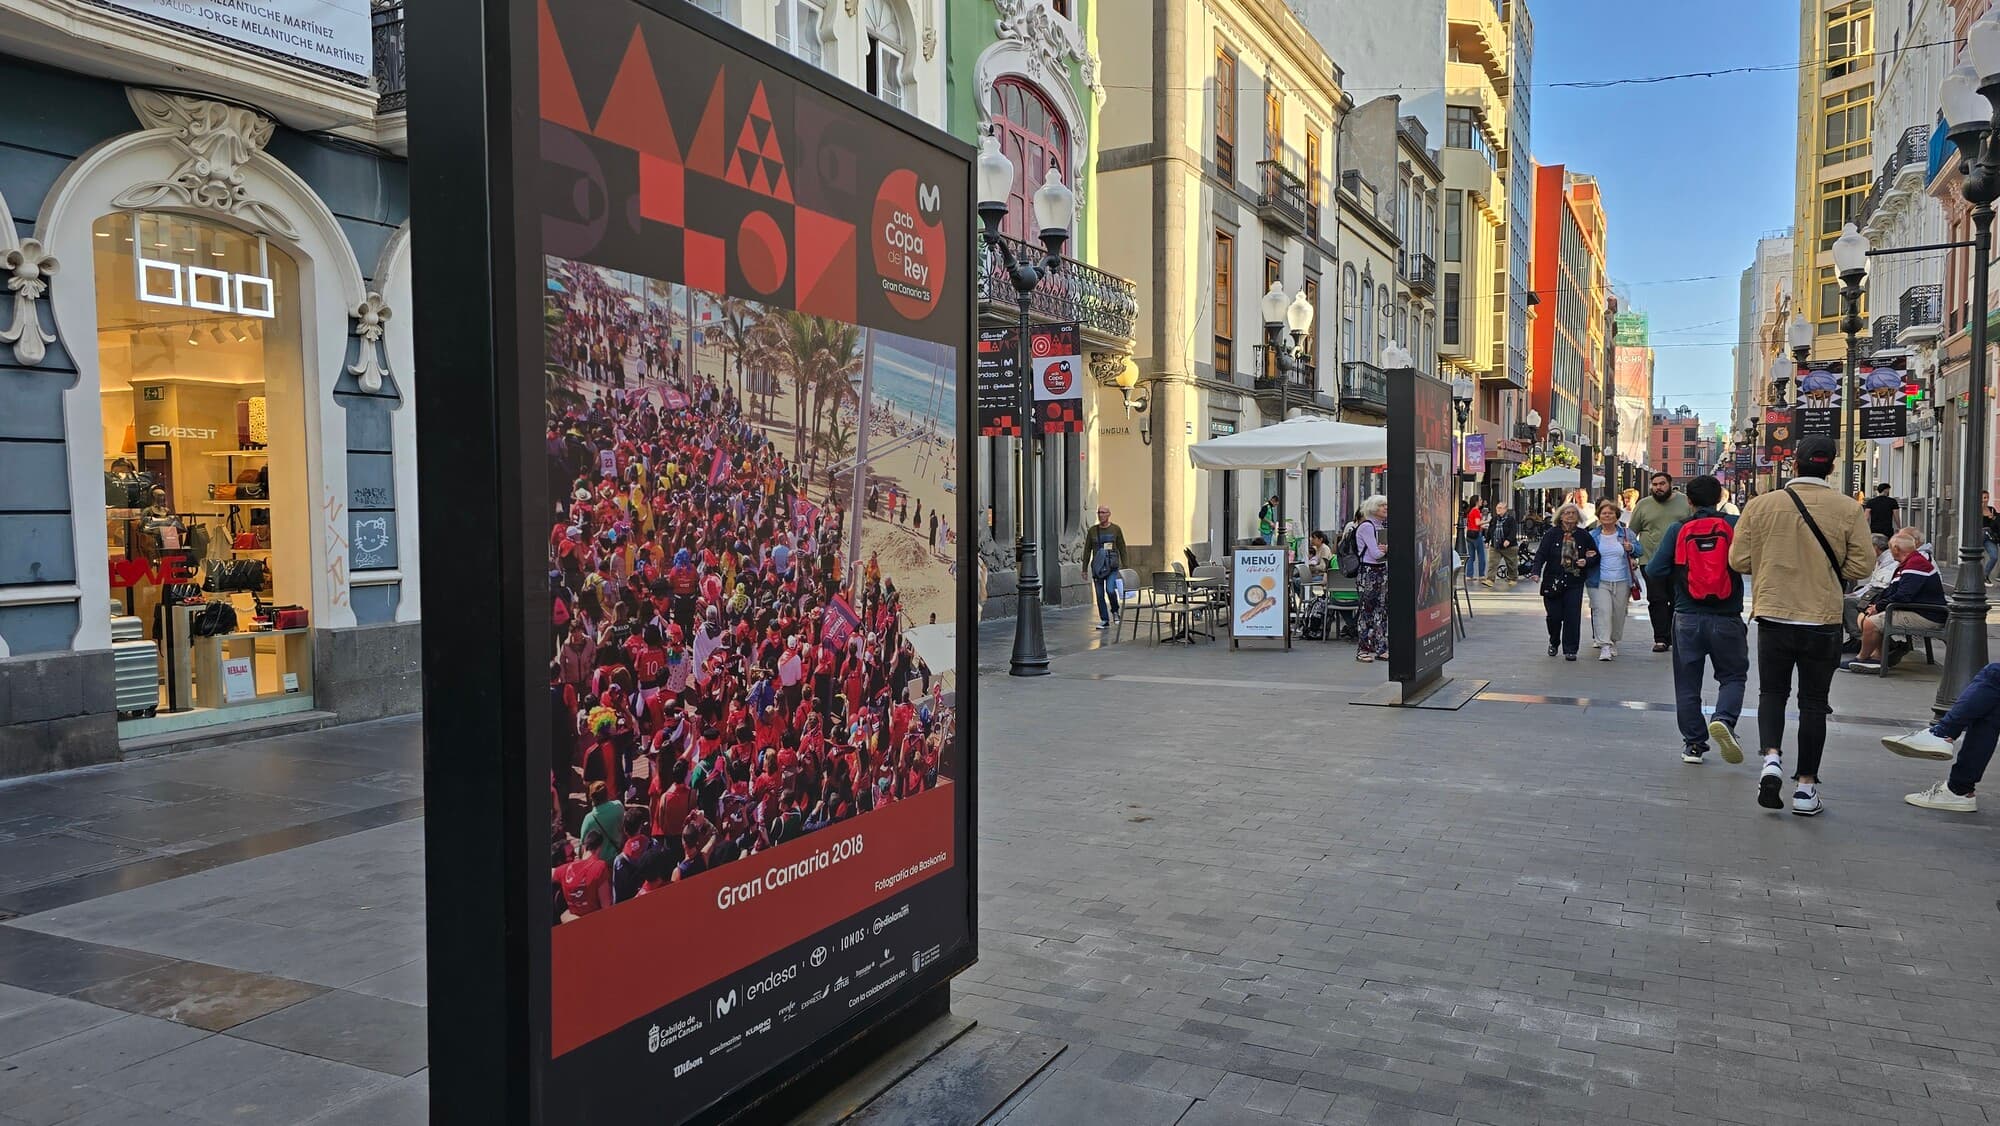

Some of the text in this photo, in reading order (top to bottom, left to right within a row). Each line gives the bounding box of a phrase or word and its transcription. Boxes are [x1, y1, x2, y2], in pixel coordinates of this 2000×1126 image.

[199, 7, 238, 27] JORGE
[241, 19, 313, 49] MELANTUCHE
[315, 41, 365, 65] MARTÍNEZ
[283, 14, 334, 39] MARTÍNEZ
[893, 210, 914, 229] acb
[885, 222, 923, 255] Copa
[904, 255, 928, 286] Rey
[882, 279, 898, 292] Gran
[898, 283, 922, 299] Canaria
[1241, 553, 1276, 566] MENÚ
[646, 660, 658, 675] 10
[717, 834, 864, 910] Gran Canaria 2018
[875, 850, 947, 892] Fotografía de Baskonia
[873, 907, 910, 935] mediolanum
[841, 928, 864, 951] IONOS
[747, 964, 797, 1000] endesa
[848, 995, 860, 1008] Con
[866, 973, 899, 998] colaboración
[660, 1015, 695, 1038] Cabildo de
[660, 1021, 703, 1047] Gran Canaria
[673, 1057, 703, 1078] Wilson
